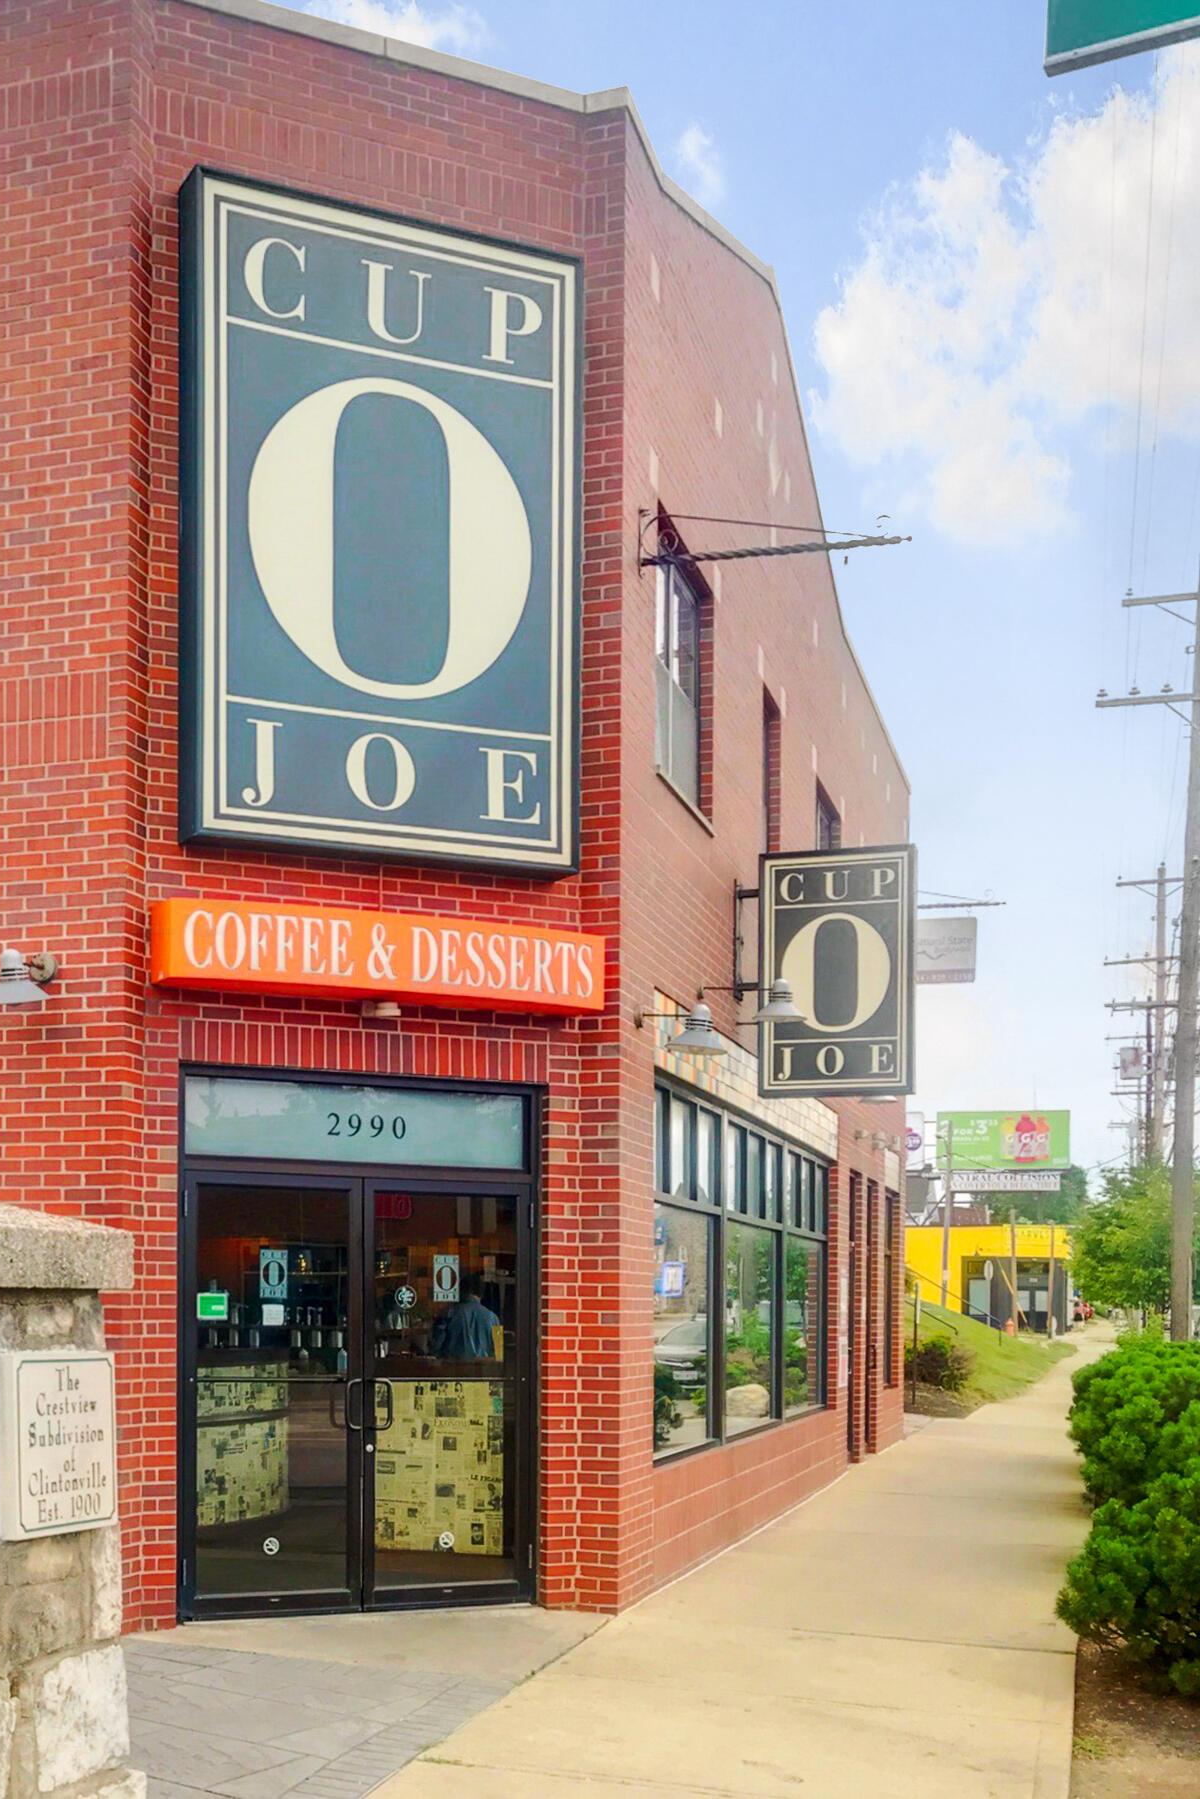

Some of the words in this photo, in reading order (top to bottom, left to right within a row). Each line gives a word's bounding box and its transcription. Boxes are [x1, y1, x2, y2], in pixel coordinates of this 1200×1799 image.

[243, 236, 543, 365] CUP
[246, 376, 532, 700] O
[241, 718, 541, 826] JOE
[779, 867, 896, 903] CUP
[183, 909, 355, 978] COFFEE
[366, 922, 398, 981] &
[411, 926, 594, 999] DESSERTS
[780, 912, 891, 1033] O
[777, 1044, 895, 1081] JOE
[326, 1112, 408, 1140] 2990
[953, 1127, 975, 1136] FOR
[996, 1172, 1058, 1182] COLLISION
[262, 1260, 286, 1288] O
[436, 1265, 458, 1292] O
[55, 1365, 80, 1393] The
[35, 1392, 98, 1417] Crestview
[28, 1420, 105, 1449] Subdivision
[62, 1446, 76, 1473] of
[27, 1461, 108, 1498] Clintonville
[37, 1498, 64, 1524] Est.
[70, 1492, 101, 1520] 1900
